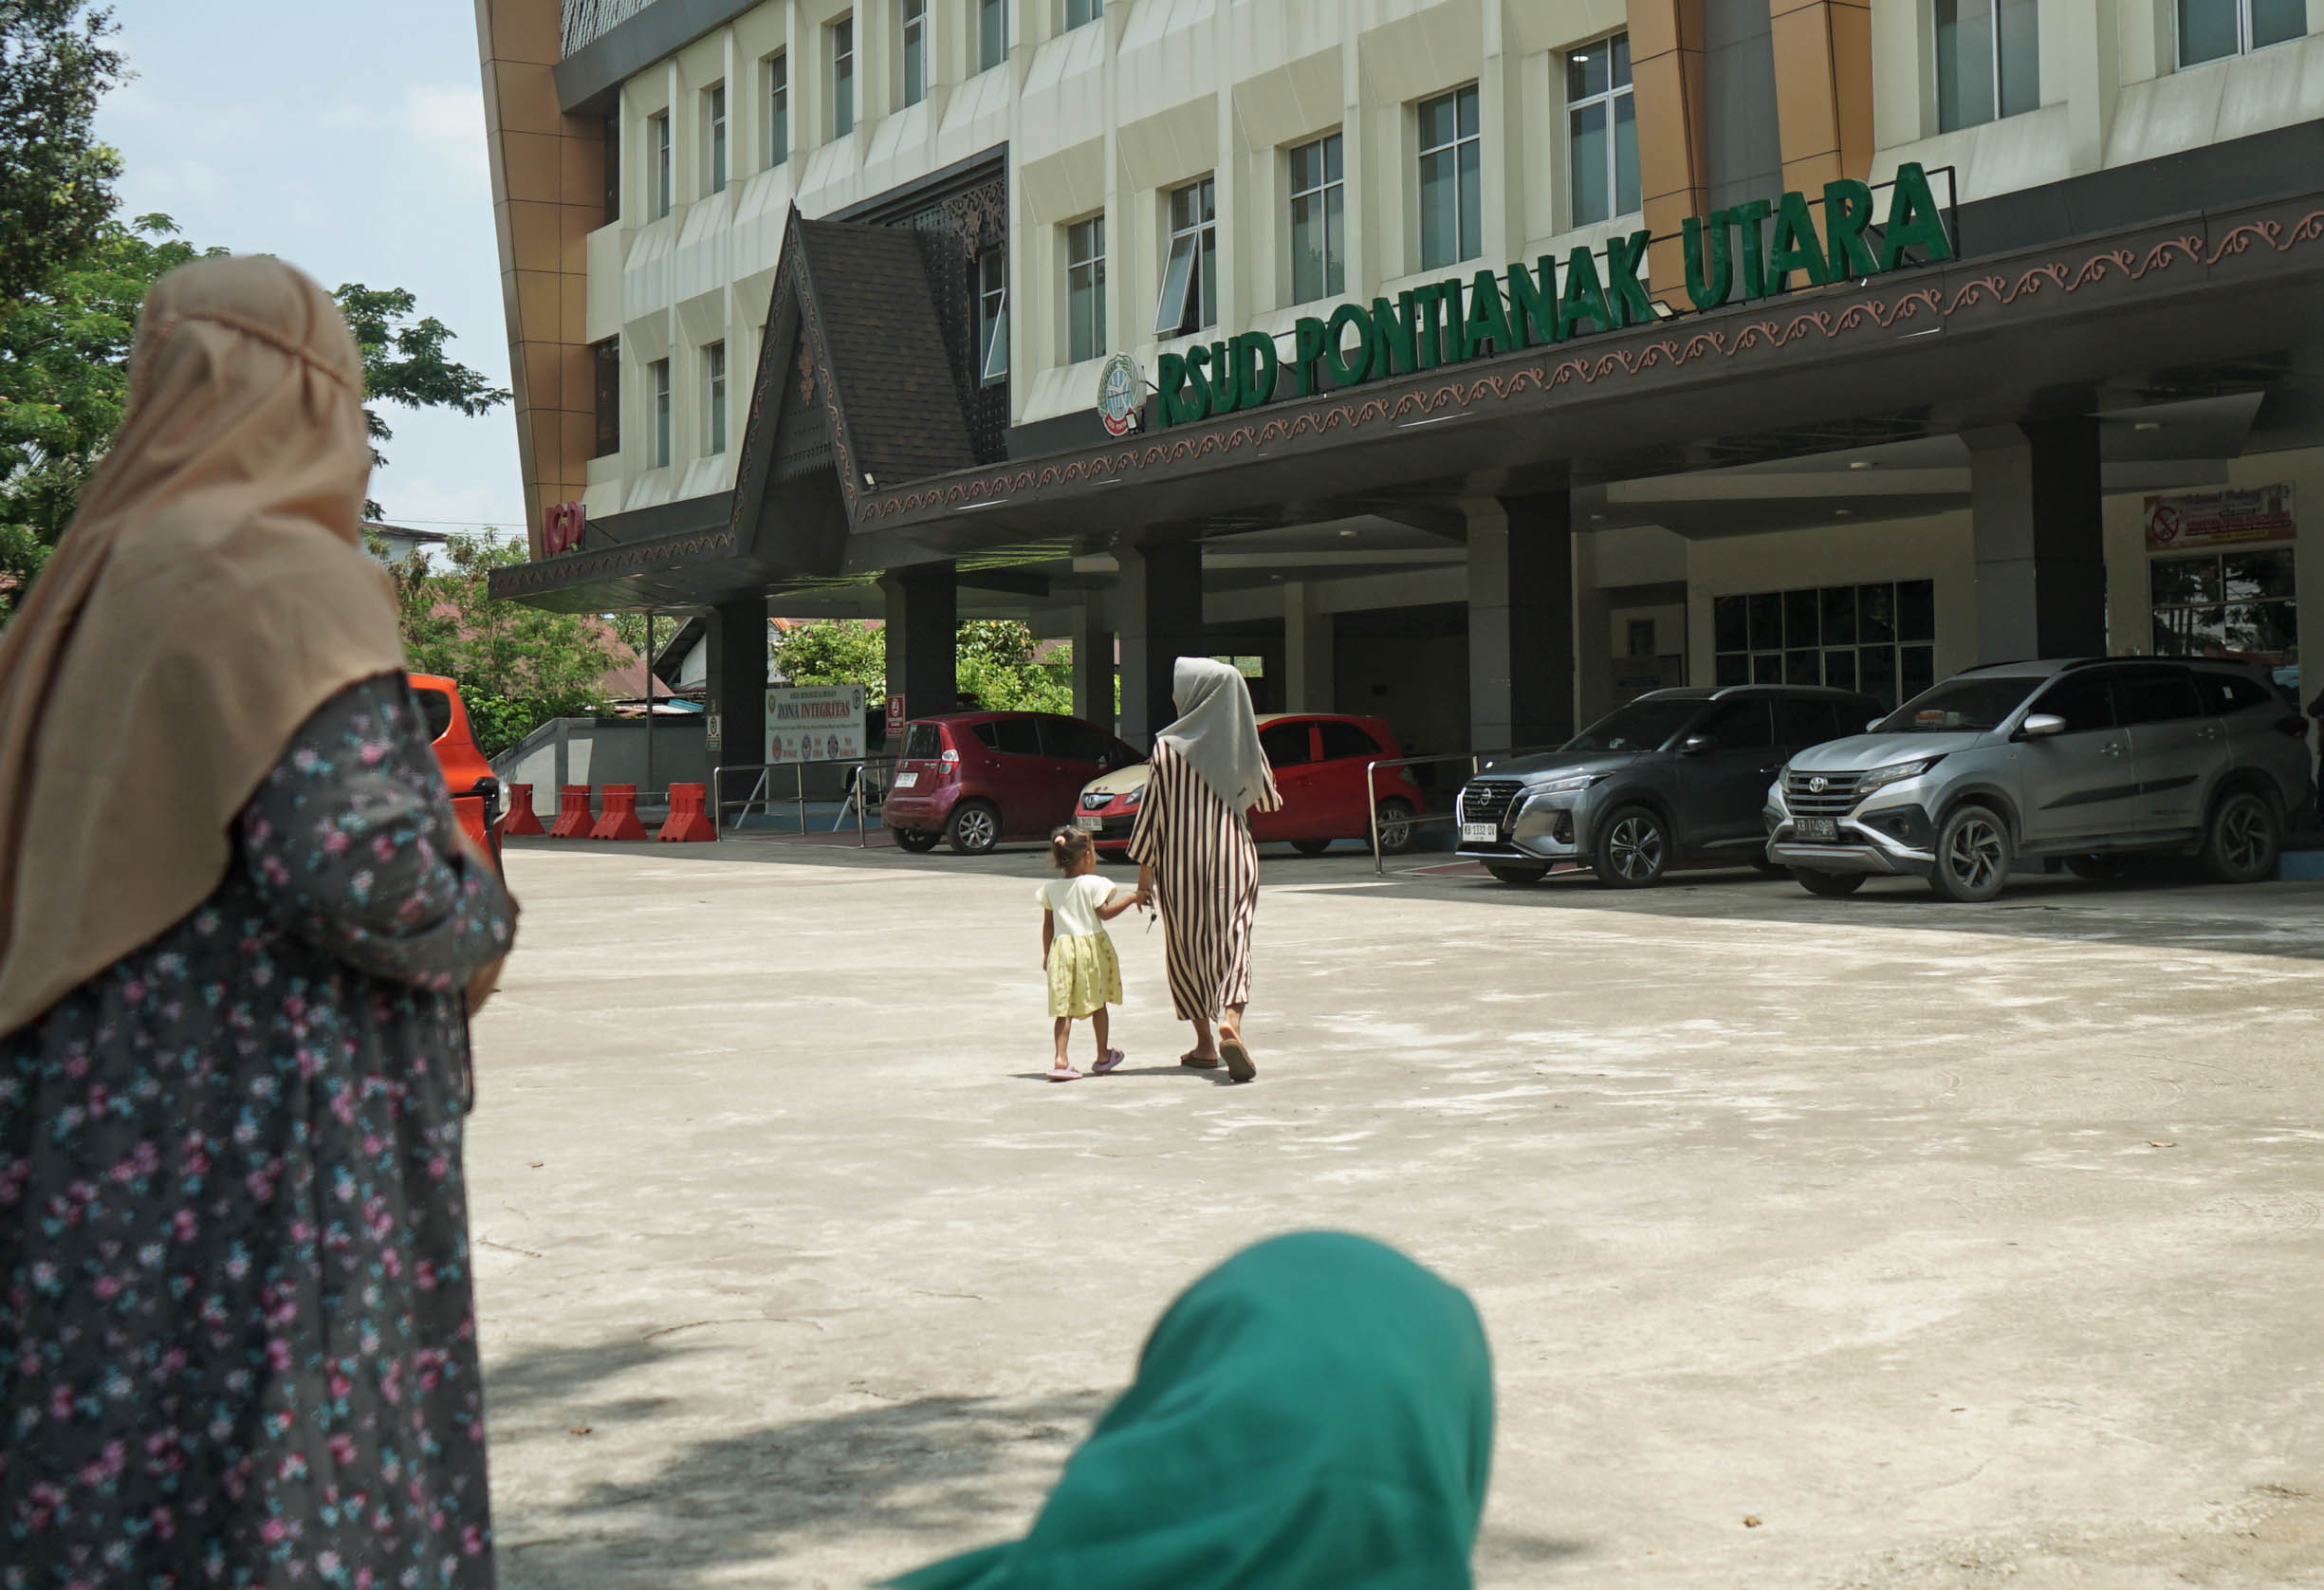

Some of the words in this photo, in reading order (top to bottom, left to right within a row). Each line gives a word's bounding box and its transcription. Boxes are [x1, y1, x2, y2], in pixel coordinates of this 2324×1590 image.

[1158, 331, 1278, 427] RSUD
[1296, 230, 1657, 396] PONTIANAK
[1681, 162, 1952, 309] UTARA
[777, 702, 799, 720] ZONA
[801, 699, 850, 719] INTEGRITAS
